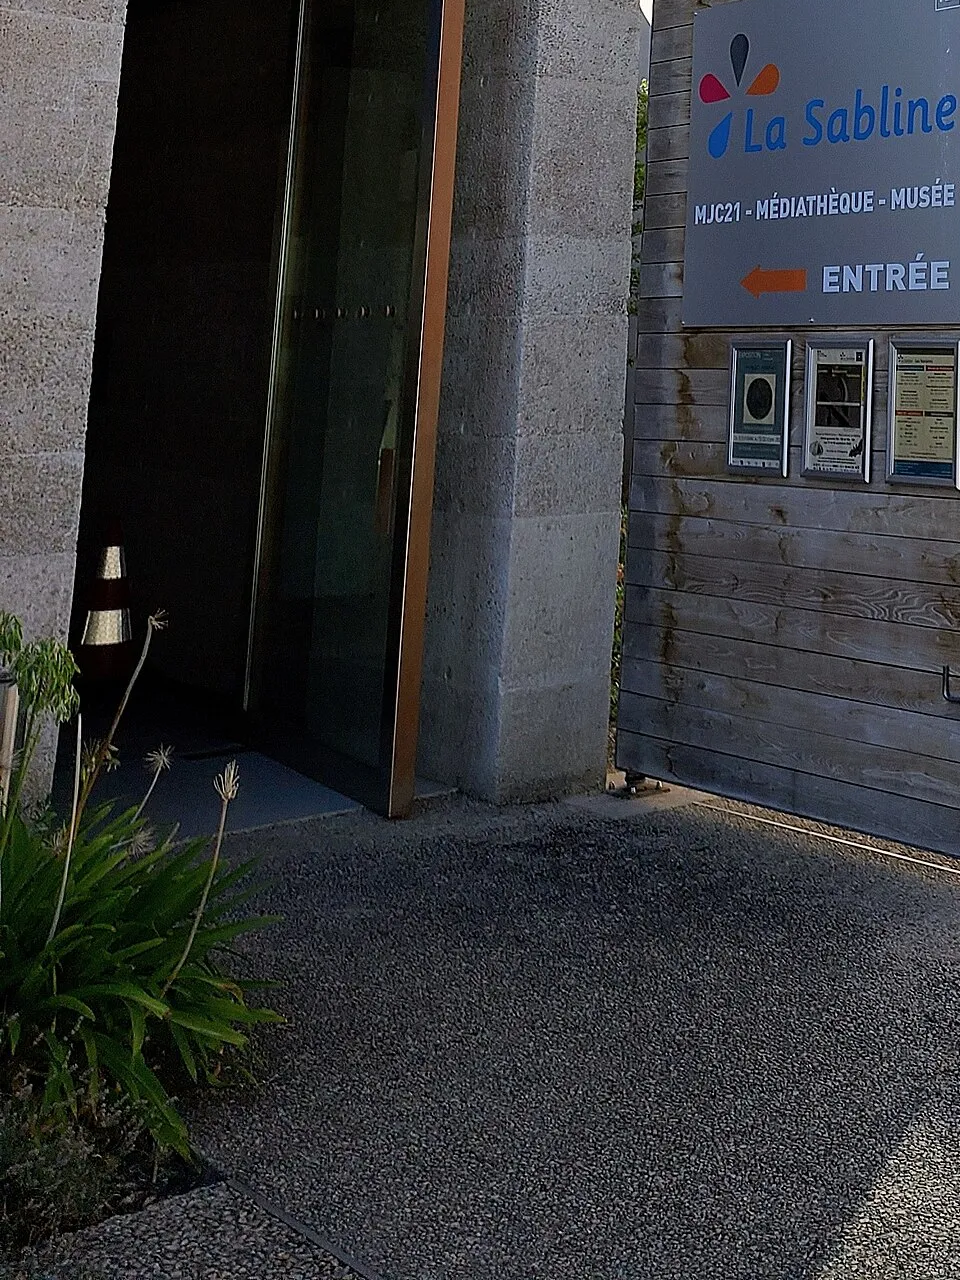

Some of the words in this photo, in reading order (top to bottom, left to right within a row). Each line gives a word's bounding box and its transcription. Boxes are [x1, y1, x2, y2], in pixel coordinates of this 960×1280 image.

[744, 108, 787, 153] La
[802, 85, 958, 147] Sabline
[694, 202, 741, 225] MJC21
[755, 188, 874, 221] MÉDIATHÈQUE
[890, 178, 956, 211] MUSÉE
[821, 253, 950, 294] ENTRÉE
